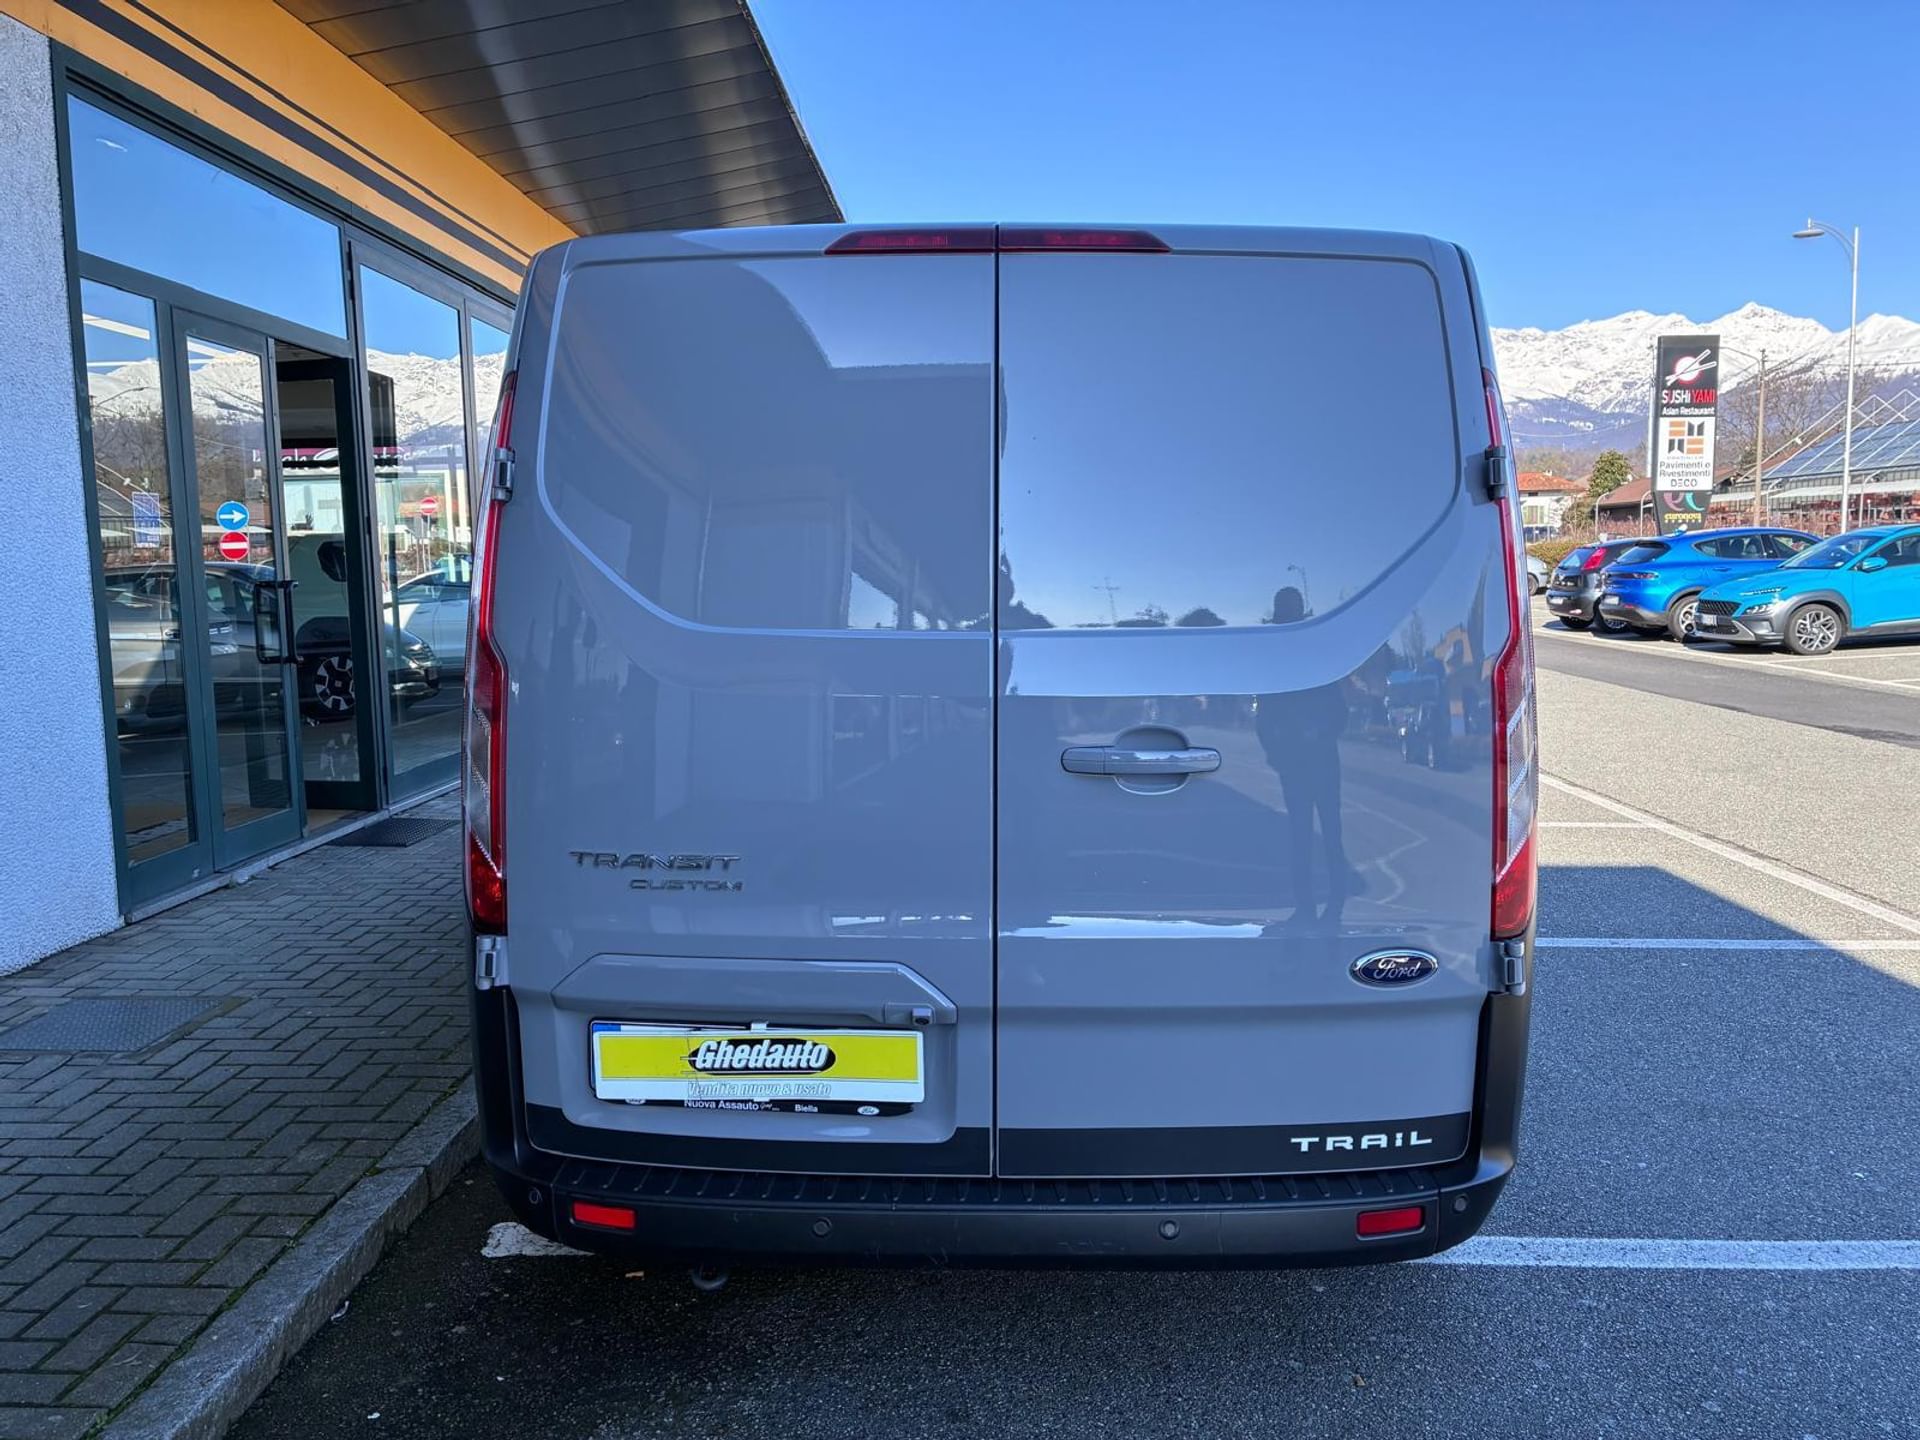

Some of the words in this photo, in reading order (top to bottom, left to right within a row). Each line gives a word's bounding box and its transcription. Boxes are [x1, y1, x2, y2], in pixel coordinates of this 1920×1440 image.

[1662, 389, 1691, 404] SUSHI
[1691, 389, 1716, 404] YAMI
[1662, 406, 1680, 416] Asian
[1680, 406, 1715, 415] Restaurant
[1659, 461, 1703, 469] Pavimenti
[1659, 469, 1711, 477] Rivestimenti
[1670, 478, 1698, 488] DECO
[568, 850, 742, 872] TRANSIT
[629, 879, 743, 892] CUSTOM
[1372, 957, 1421, 980] Ford
[695, 1039, 829, 1070] Ghedauto
[687, 1081, 738, 1097] Vendita
[742, 1083, 780, 1097] nuovo
[781, 1084, 791, 1097] &
[794, 1083, 832, 1097] usato
[684, 1099, 716, 1109] Nuova
[717, 1100, 760, 1111] Assauto
[795, 1103, 818, 1113] Biella
[1290, 1131, 1432, 1152] TRAIL
